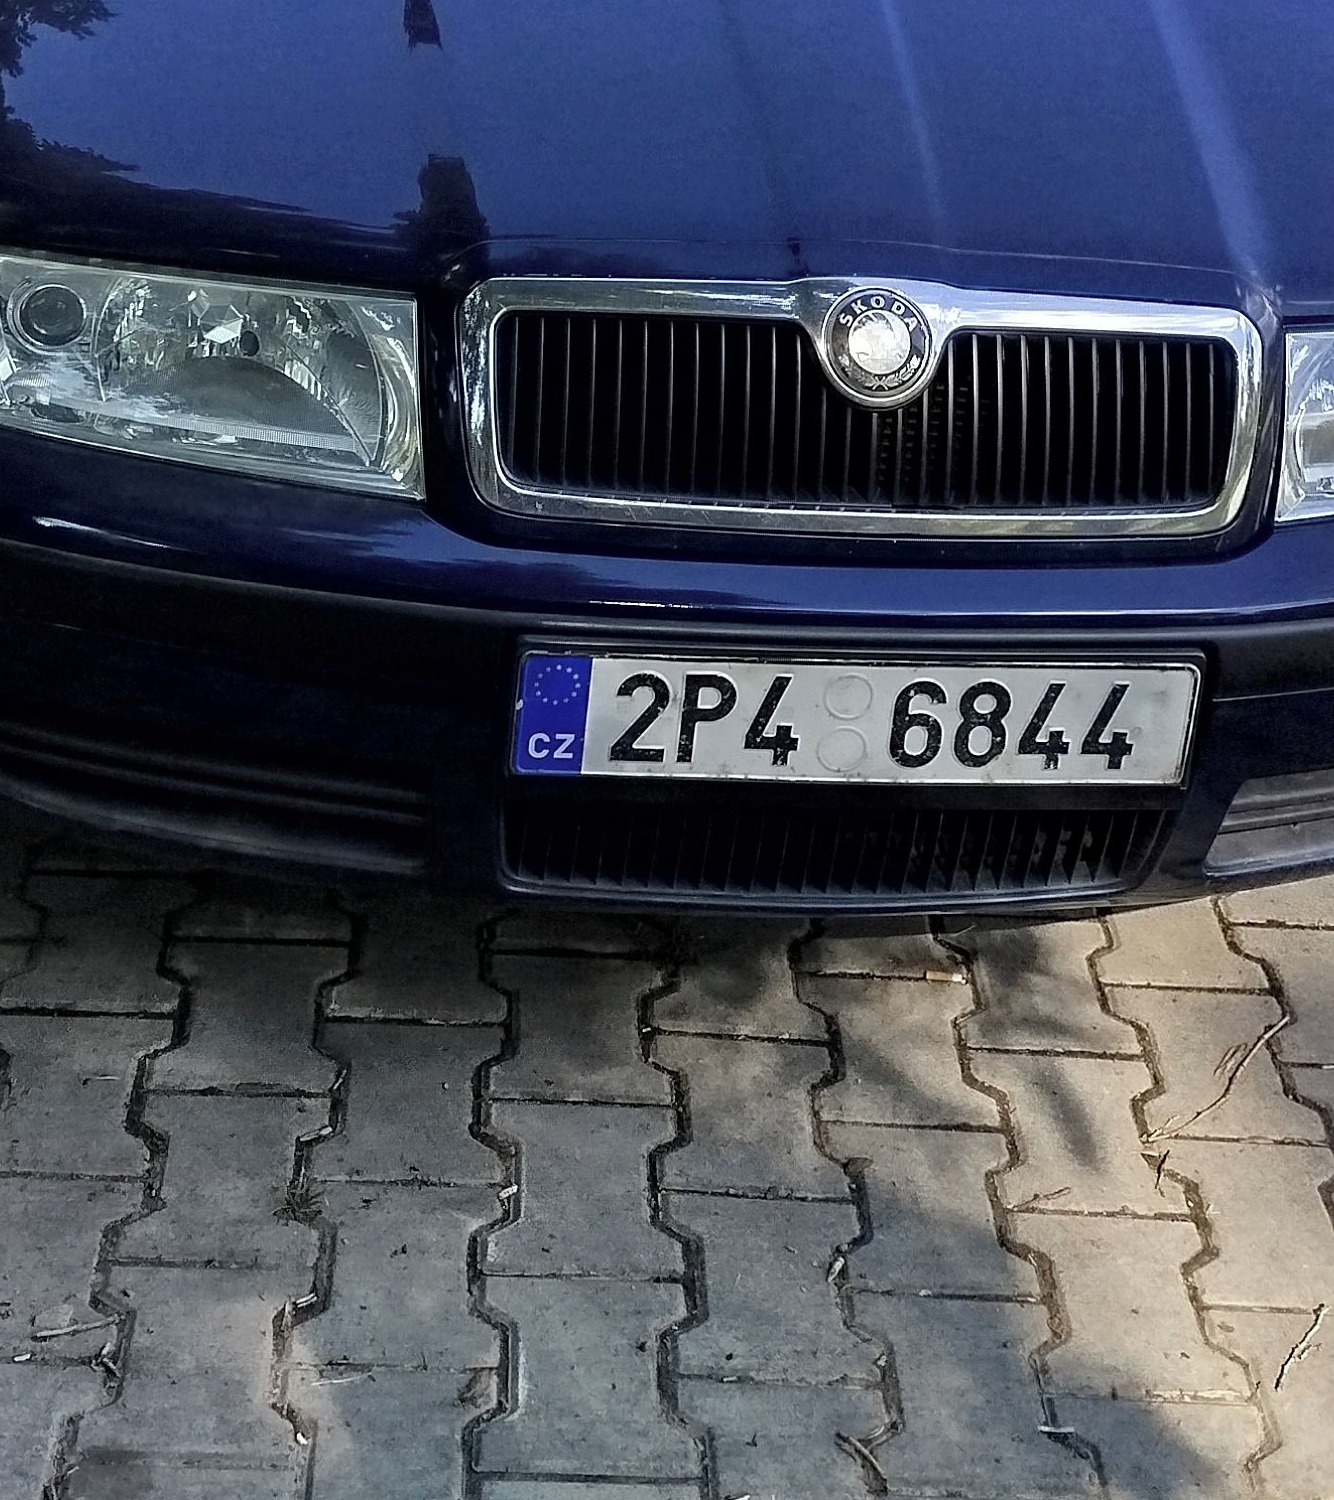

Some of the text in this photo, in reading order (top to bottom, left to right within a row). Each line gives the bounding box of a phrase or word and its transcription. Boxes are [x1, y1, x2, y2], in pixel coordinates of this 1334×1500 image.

[528, 733, 575, 759] CZ
[609, 672, 1134, 770] 2P4 6844
